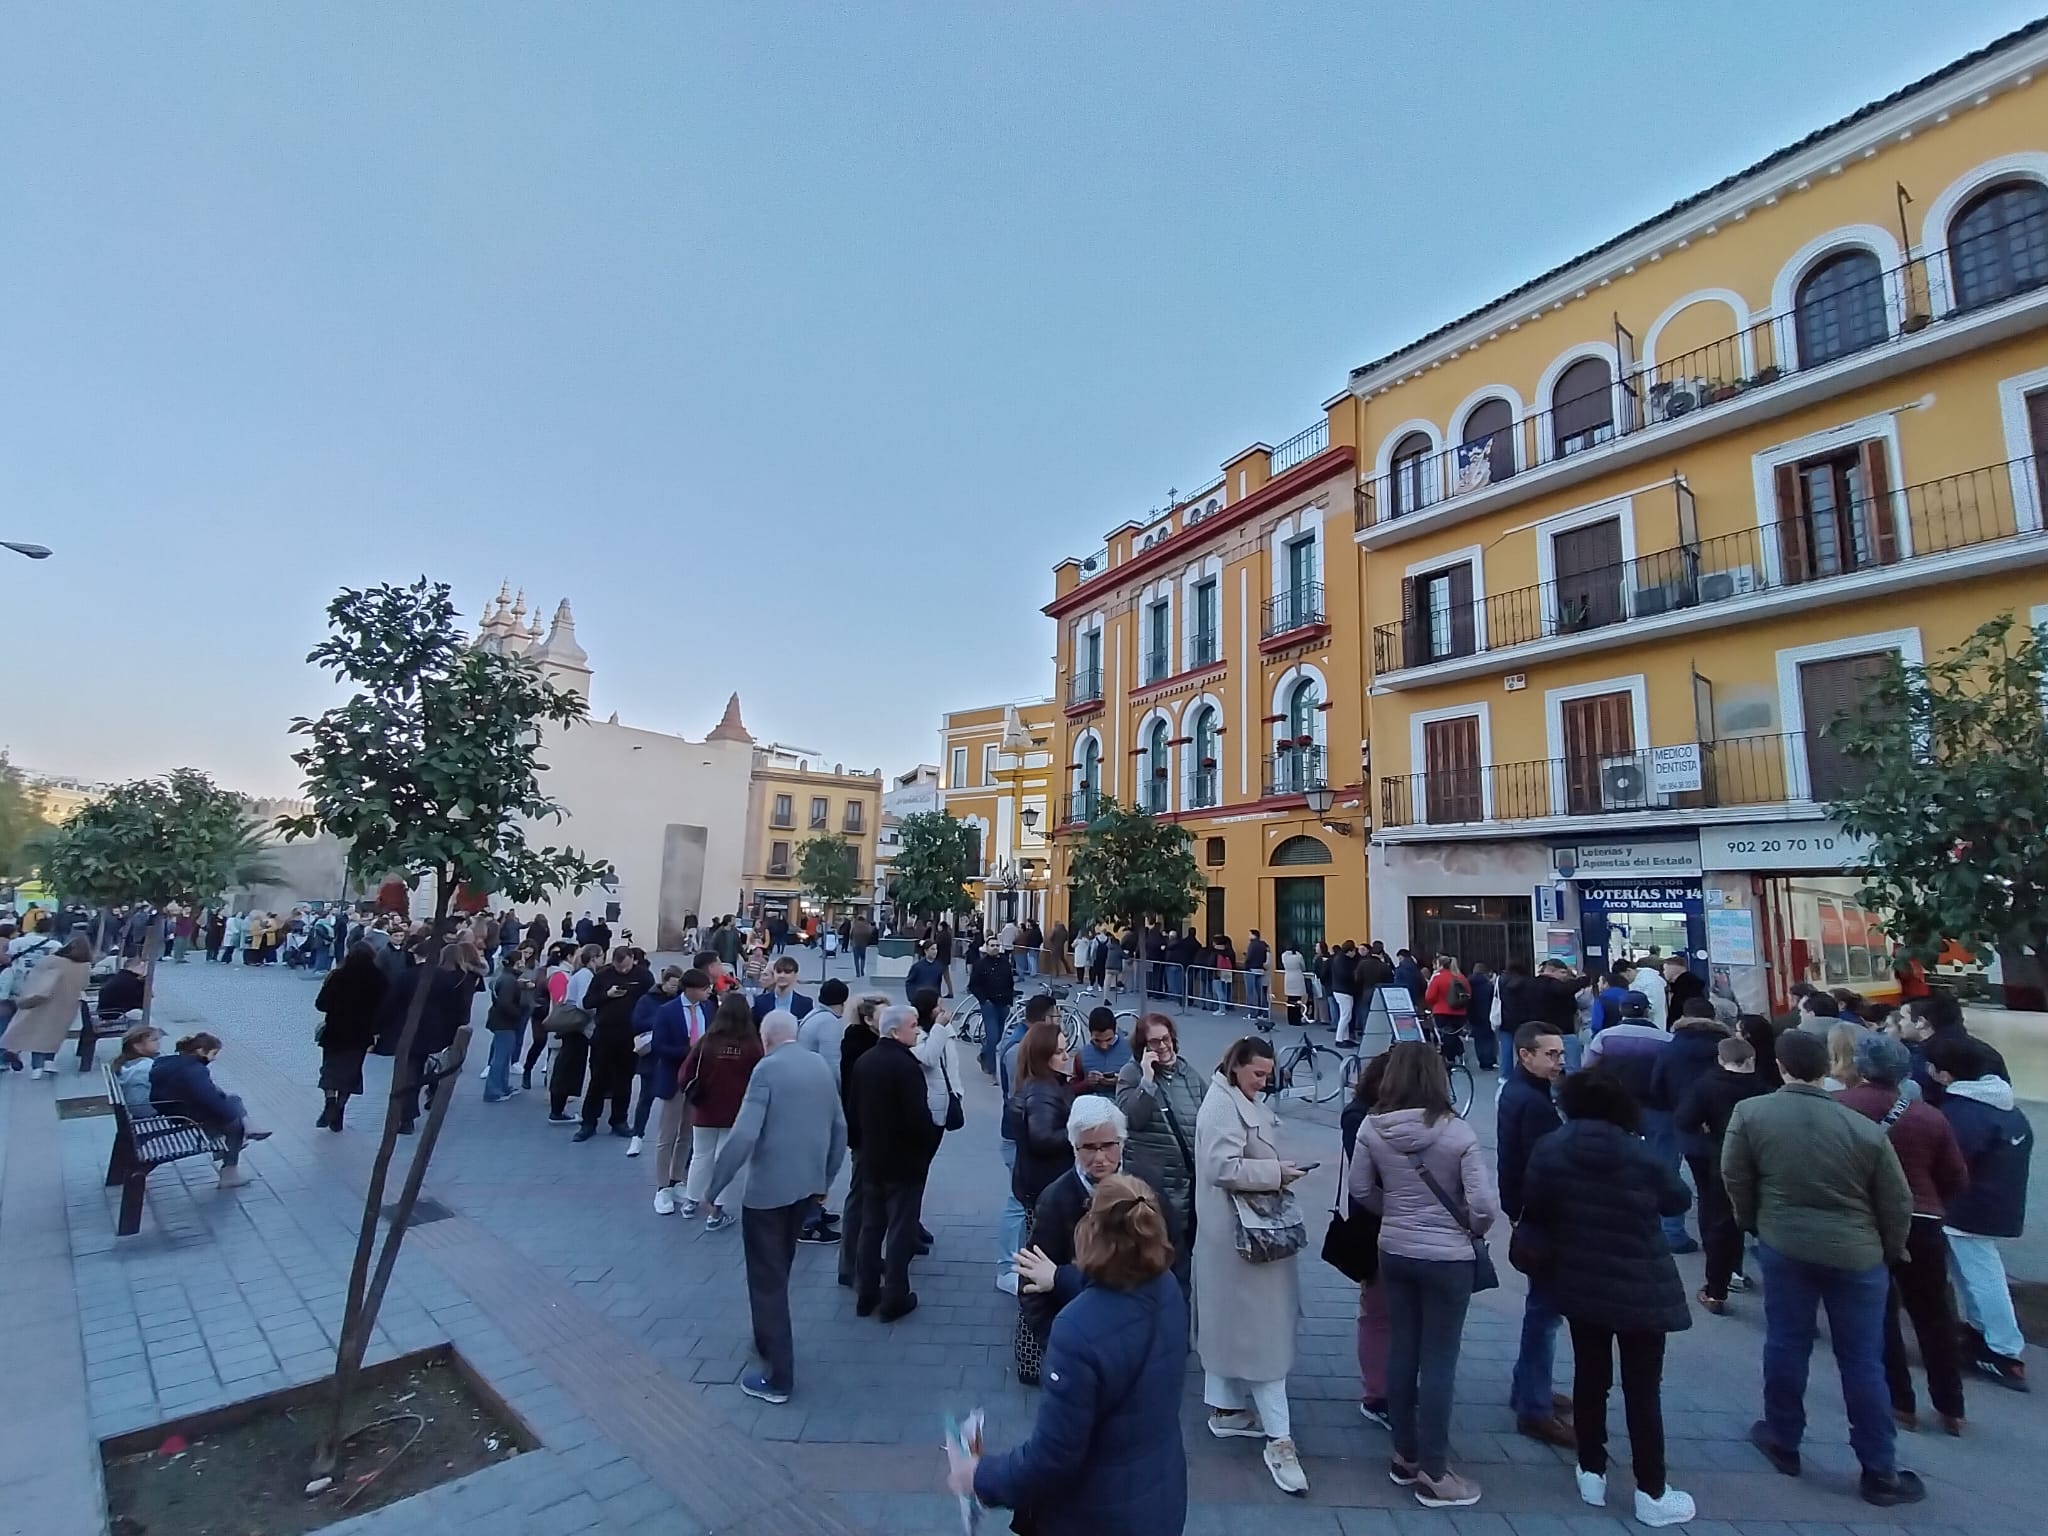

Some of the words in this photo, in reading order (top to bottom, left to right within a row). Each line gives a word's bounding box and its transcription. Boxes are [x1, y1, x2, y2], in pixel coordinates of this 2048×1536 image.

[1655, 747, 1693, 760] MEDICO
[1656, 761, 1698, 774] DENTISTA
[1626, 847, 1633, 857] y
[1727, 841, 1756, 853] 902
[1761, 840, 1781, 852] 20
[1787, 839, 1807, 851] 70
[1814, 838, 1834, 850] 10
[1582, 859, 1631, 869] Apuestas
[1633, 857, 1650, 866] del
[1653, 856, 1693, 866] Estado
[1584, 886, 1661, 900] LOTERÍAS
[1602, 900, 1628, 909] Arco
[1630, 900, 1684, 909] Macarena
